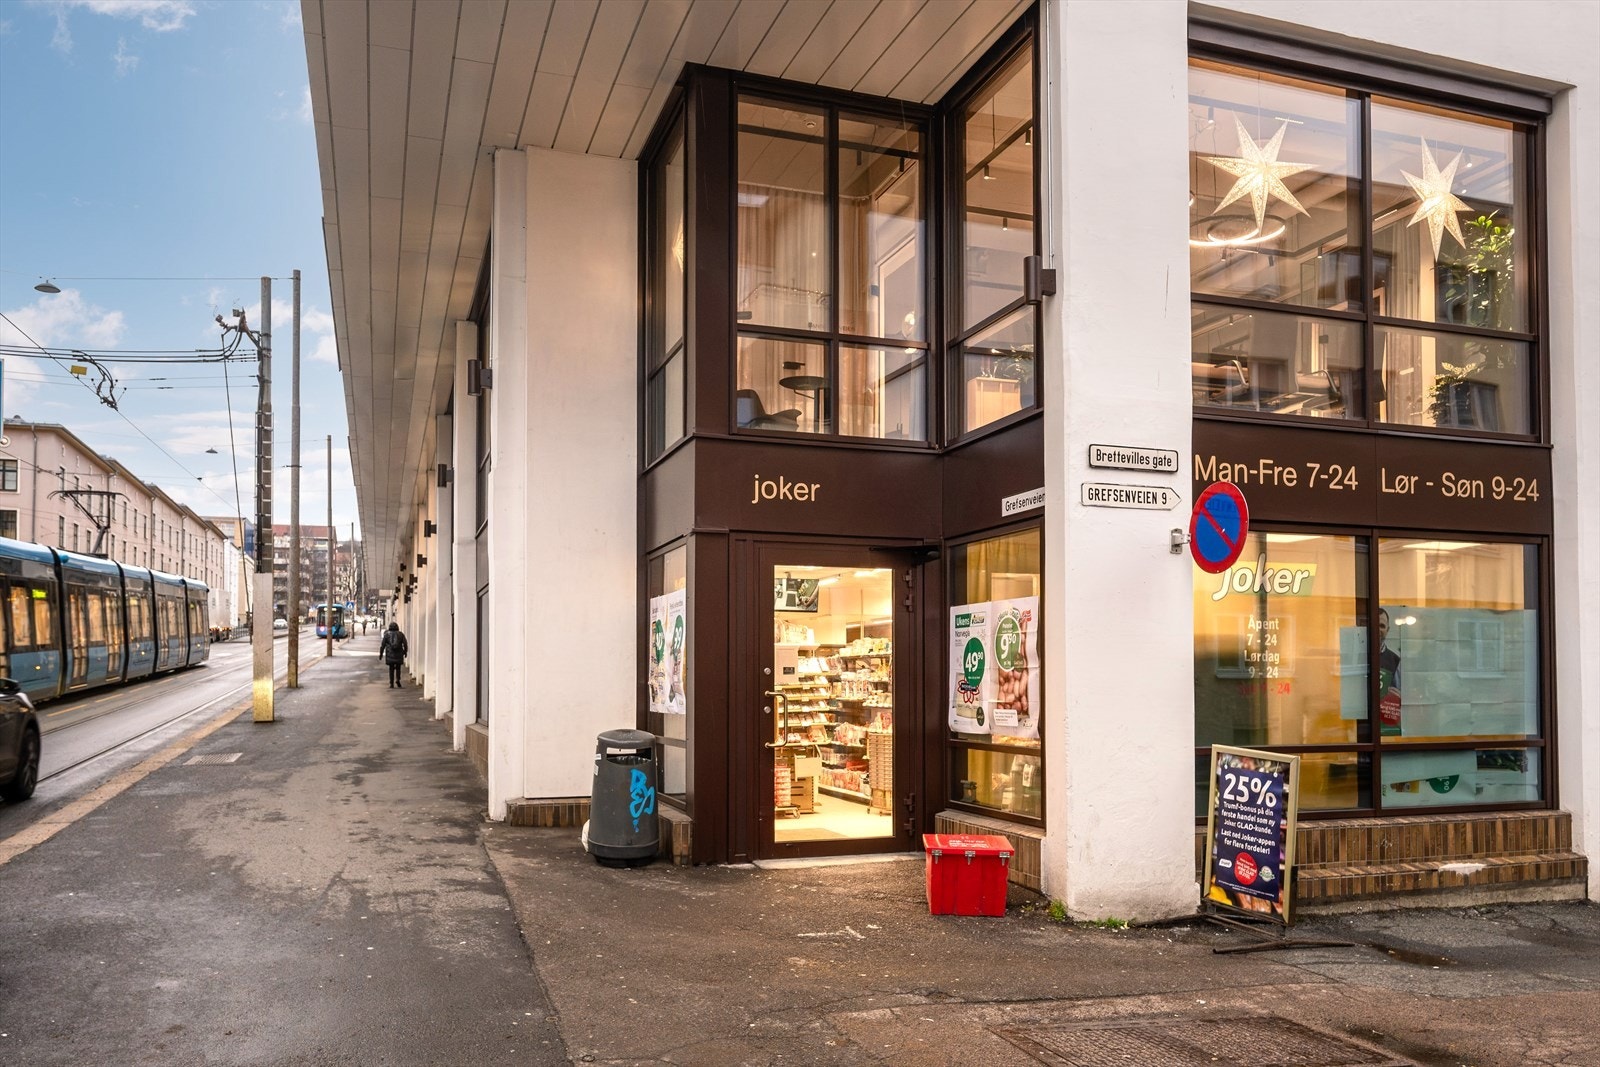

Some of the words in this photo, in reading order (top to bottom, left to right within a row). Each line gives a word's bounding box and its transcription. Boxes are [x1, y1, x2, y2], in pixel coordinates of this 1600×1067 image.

[1096, 449, 1150, 465] Brettevilles
[1152, 456, 1172, 468] gate
[1194, 454, 1297, 486] Man-Fre
[1306, 463, 1358, 490] 7-24
[752, 474, 820, 504] joker
[1381, 468, 1418, 494] Lør
[1441, 472, 1484, 499] Søn
[1492, 476, 1539, 502] 9-24
[1088, 488, 1157, 504] GREFSENVEIEN
[1162, 493, 1167, 504] 9
[1248, 614, 1279, 631] Åpent
[1247, 634, 1253, 645] 7
[1265, 634, 1277, 645] 24
[1244, 650, 1280, 664] Lørdag
[1249, 666, 1255, 678] 9
[1267, 667, 1279, 678] 24
[1223, 773, 1276, 807] 25%
[1224, 801, 1256, 814] Trumf-bonus
[1258, 807, 1264, 815] på
[1265, 808, 1273, 816] din
[1237, 813, 1256, 821] handel
[1233, 840, 1244, 849] flere
[1241, 833, 1275, 847] Joker-appen
